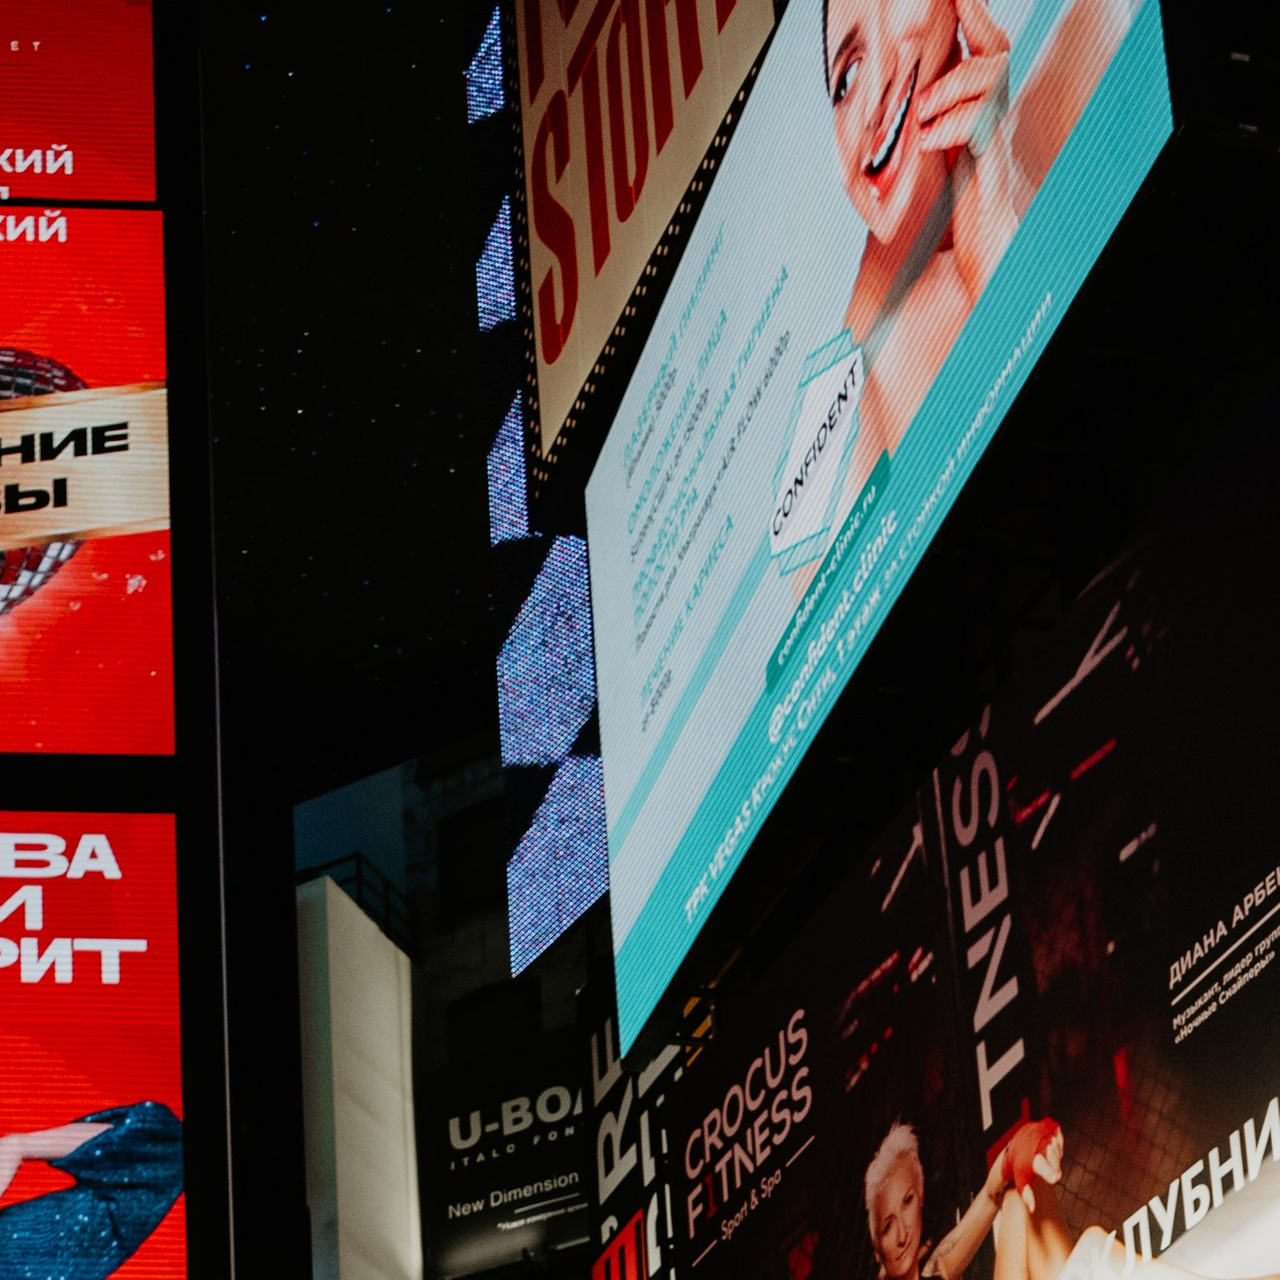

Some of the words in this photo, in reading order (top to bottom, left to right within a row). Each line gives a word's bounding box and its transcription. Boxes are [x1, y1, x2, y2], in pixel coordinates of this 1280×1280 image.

[772, 355, 857, 543] CONFIDENT
[778, 470, 876, 670] confident-clinic.ru
[767, 492, 898, 755] @confident.clinic
[709, 792, 751, 887] VEGAS
[1169, 920, 1228, 990] ДИАНА
[1173, 980, 1222, 1029] Музыкант,
[1222, 951, 1253, 986] лидер
[1174, 1001, 1218, 1044] «Ночные
[1218, 951, 1276, 1006] Снайперы»
[685, 1008, 808, 1179] CROCUS
[448, 1199, 485, 1219] New
[490, 1171, 579, 1208] Dimension
[450, 1143, 516, 1170] ITALO
[687, 1066, 813, 1239] FITNESS
[721, 1201, 748, 1240] Sport
[761, 1169, 782, 1199] Spa
